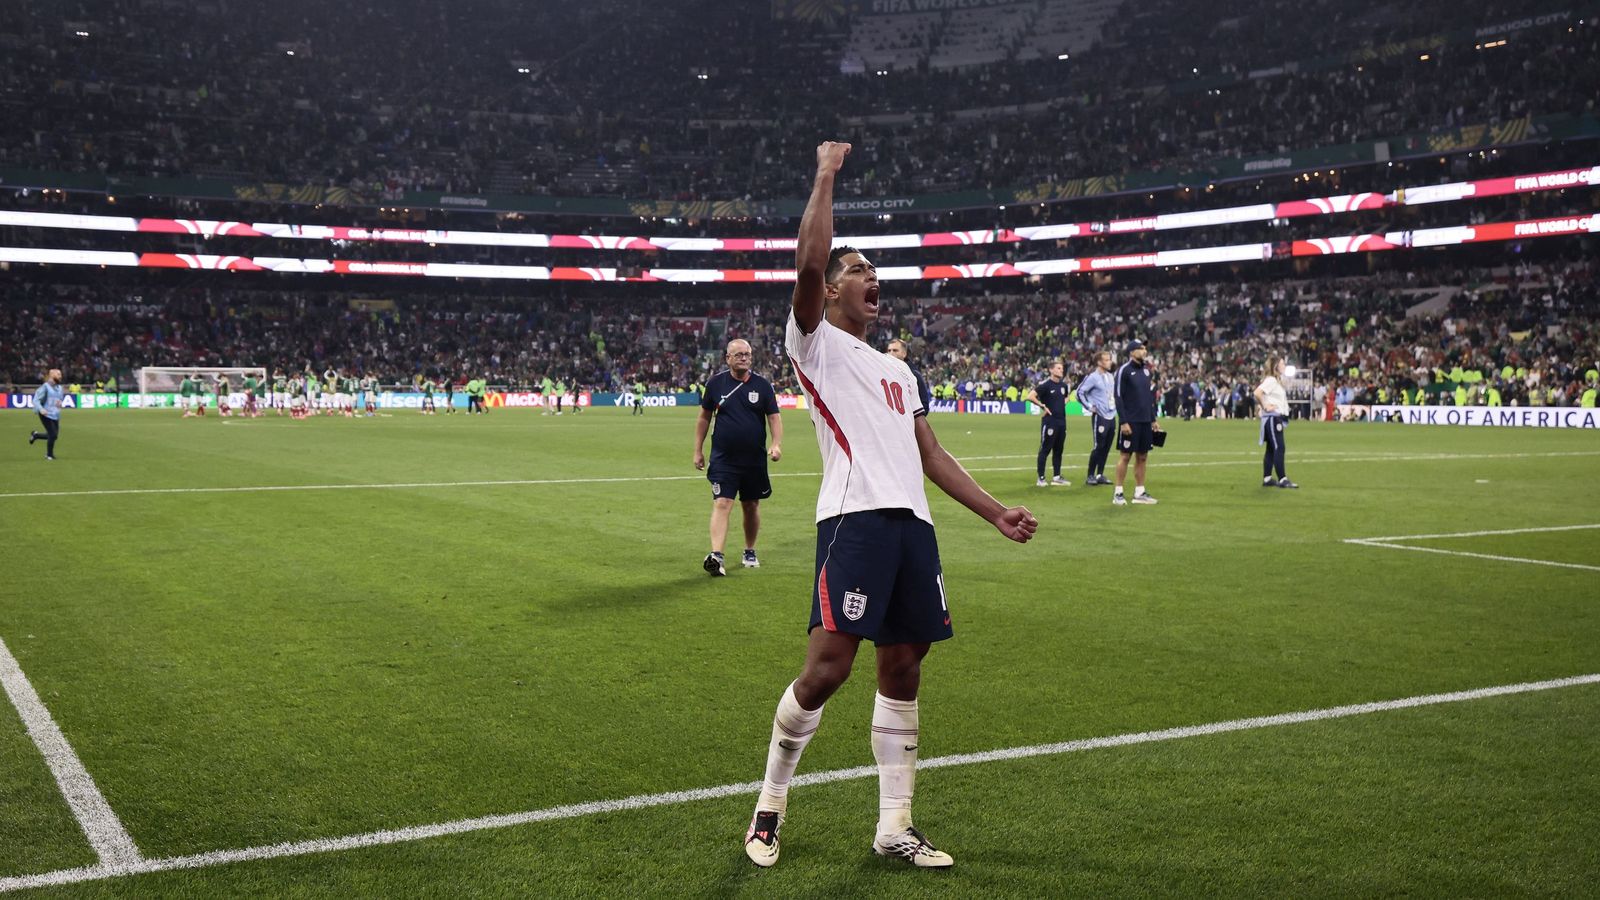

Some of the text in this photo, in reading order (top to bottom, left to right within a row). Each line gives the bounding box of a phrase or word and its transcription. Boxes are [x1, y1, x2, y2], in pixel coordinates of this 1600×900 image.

[872, 0, 911, 13] FIFA
[1475, 10, 1571, 37] MEXICO CITY
[1515, 177, 1538, 190] FIFA
[1538, 172, 1578, 187] WORLD
[832, 199, 914, 210] MEXICO CITY
[1515, 222, 1538, 235] FIFA
[1538, 219, 1578, 233] WORLD
[12, 394, 75, 408] ULA
[624, 393, 676, 406] Rxona
[881, 378, 905, 415] 10
[967, 400, 1010, 414] ULTRA
[1447, 410, 1474, 425] OF
[1482, 410, 1596, 428] AMERICA
[936, 573, 949, 611] 1
